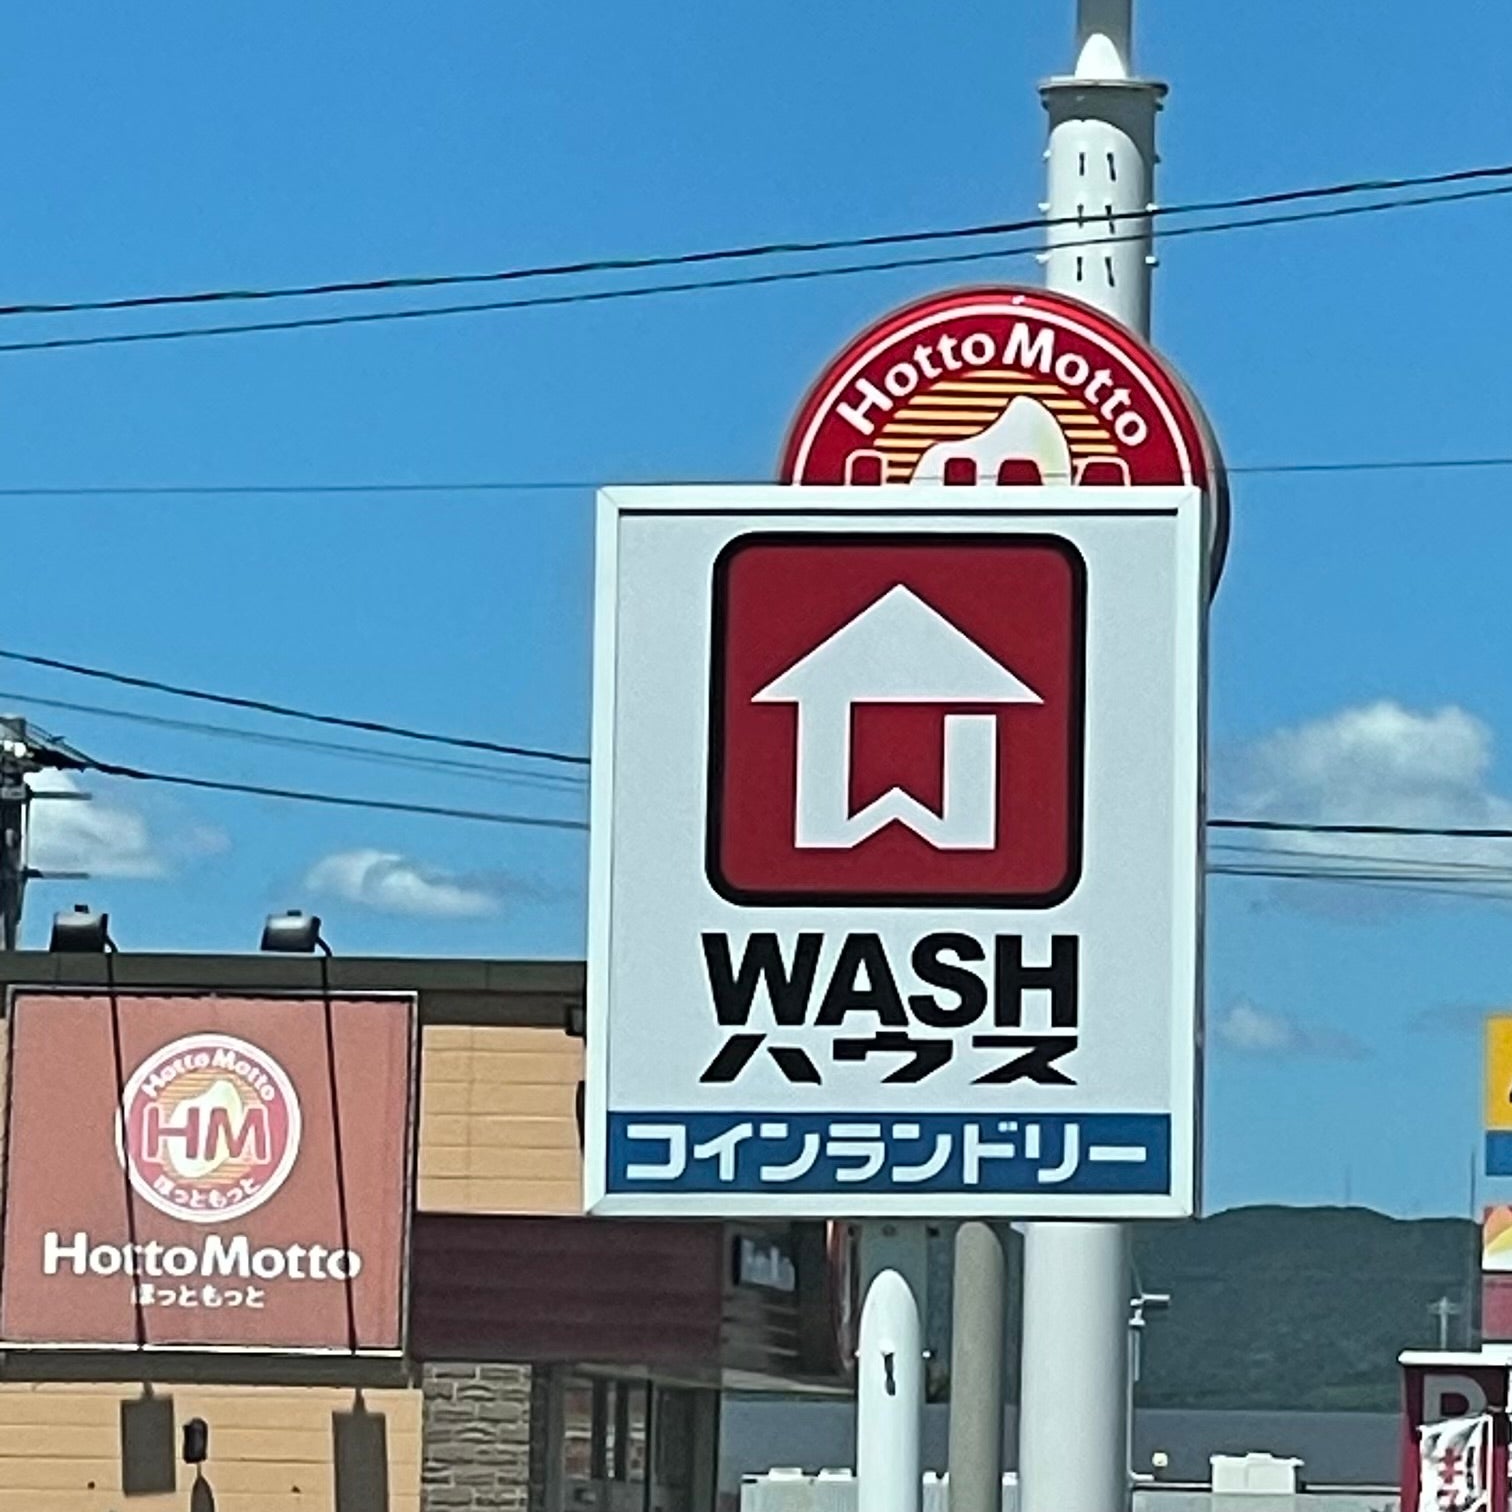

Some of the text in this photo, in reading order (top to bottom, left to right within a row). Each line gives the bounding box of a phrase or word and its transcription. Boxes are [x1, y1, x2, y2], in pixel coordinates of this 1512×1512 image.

[700, 932, 1080, 1028] WASH
[699, 1032, 1078, 1086] ハウス
[144, 1103, 270, 1163] HM
[625, 1121, 1147, 1184] コインランドリー
[130, 1283, 266, 1308] ほっともっと
